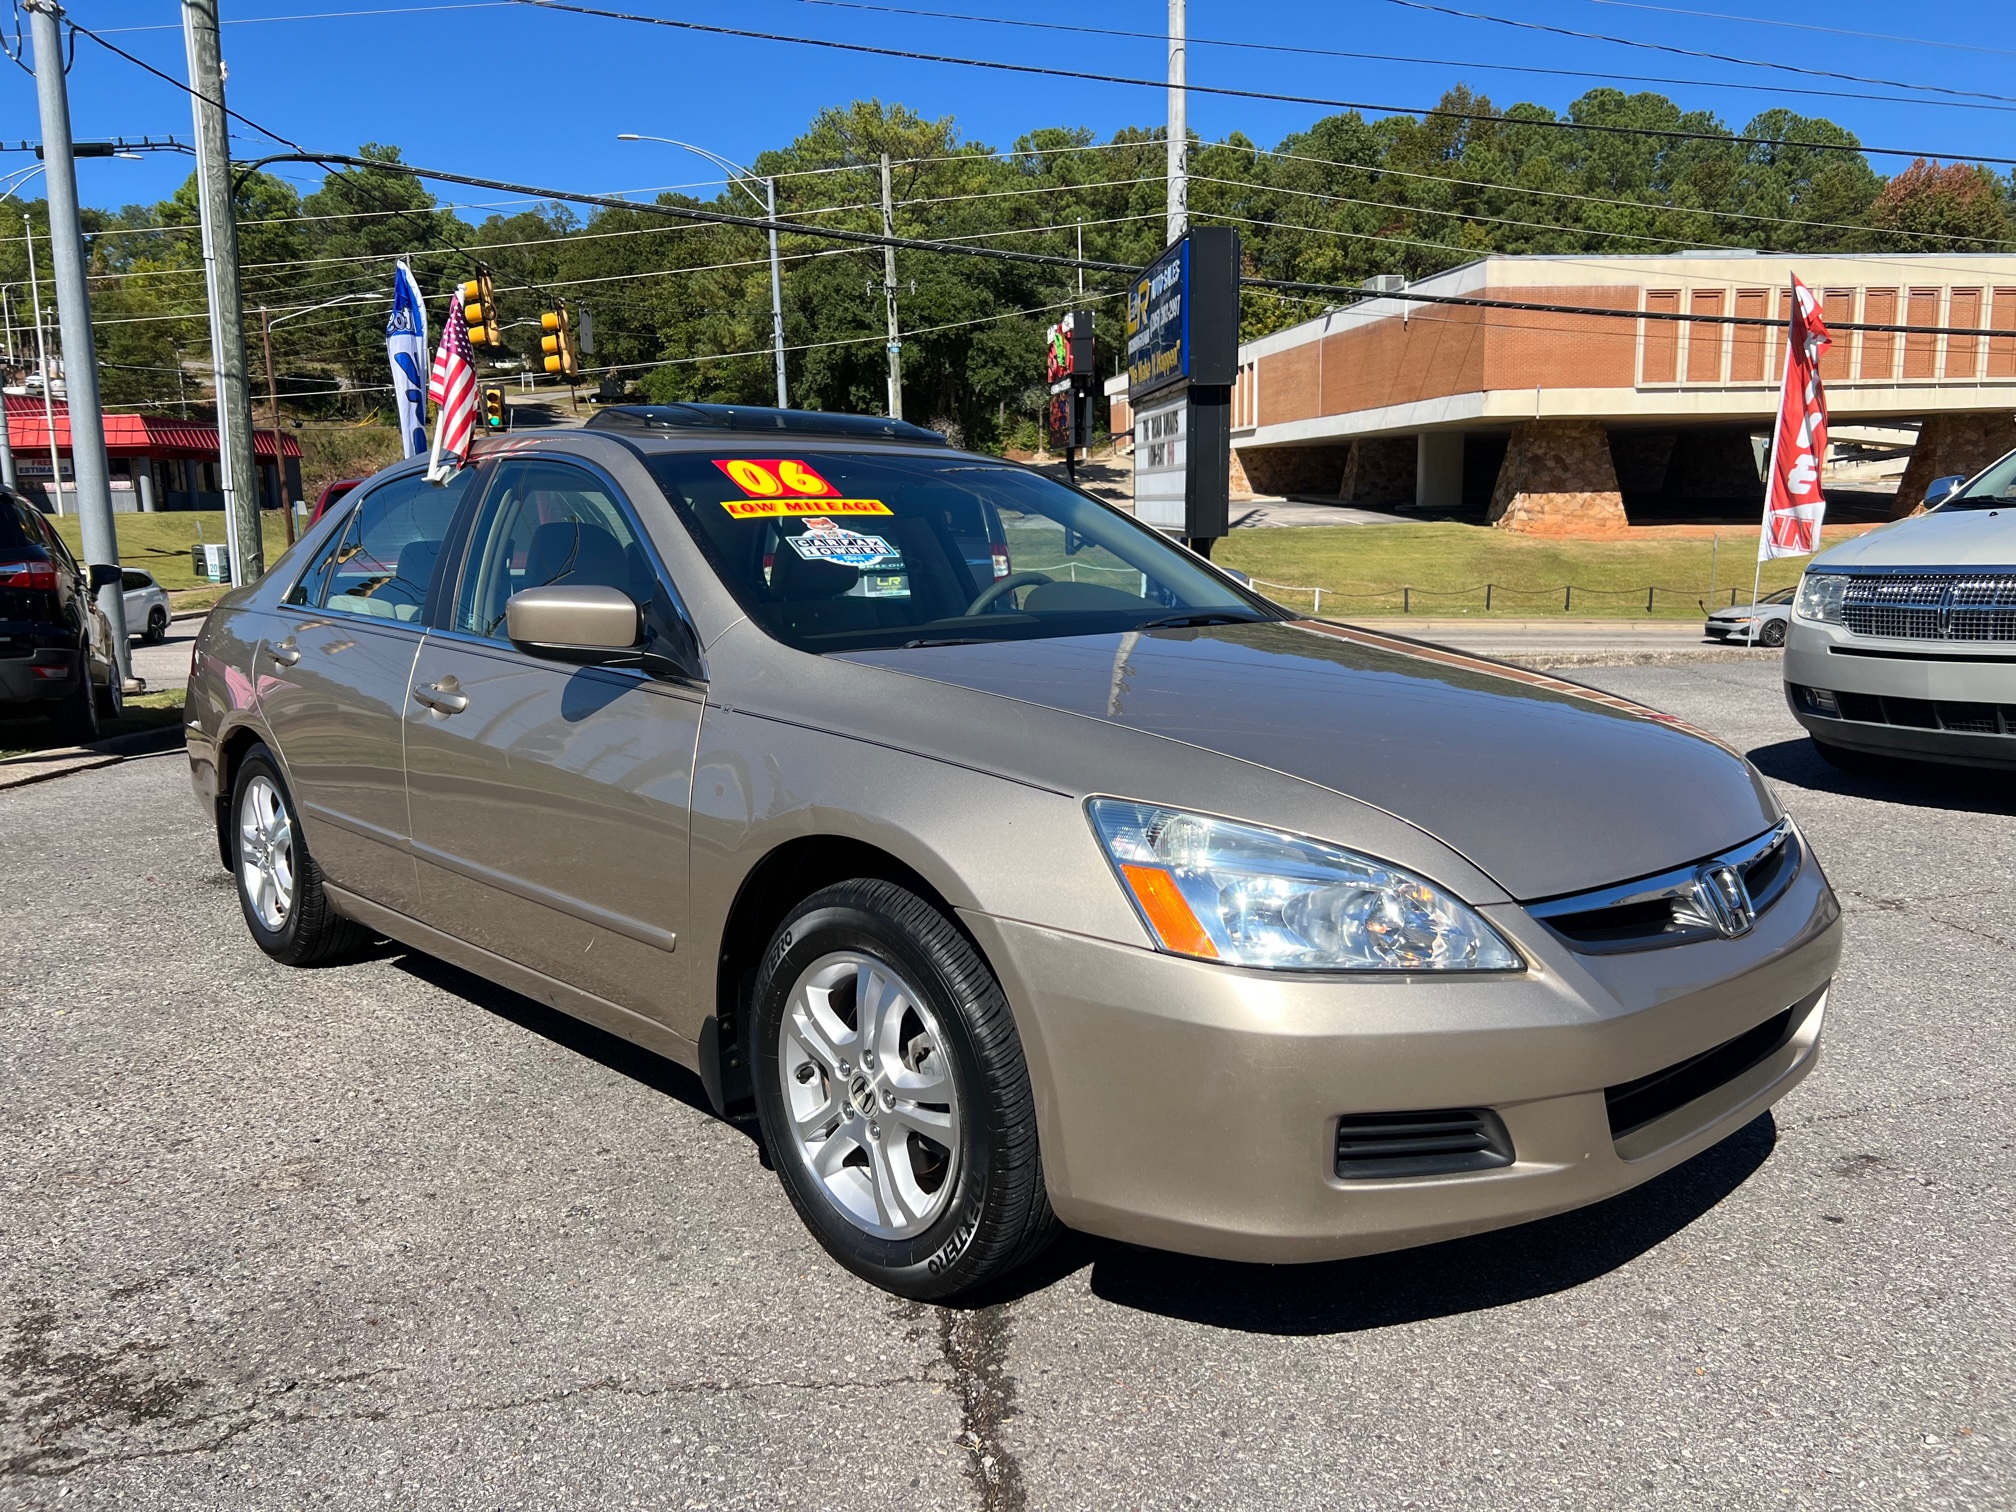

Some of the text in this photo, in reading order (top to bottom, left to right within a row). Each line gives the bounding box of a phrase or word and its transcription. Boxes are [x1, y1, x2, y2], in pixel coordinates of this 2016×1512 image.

[1164, 260, 1180, 291] SALES
[19, 466, 69, 474] ESTIMAES
[727, 460, 828, 496] 06
[728, 501, 884, 514] LOW MILEAGE
[797, 539, 882, 547] CARFAX
[819, 547, 889, 555] OWNER
[877, 576, 901, 586] LR
